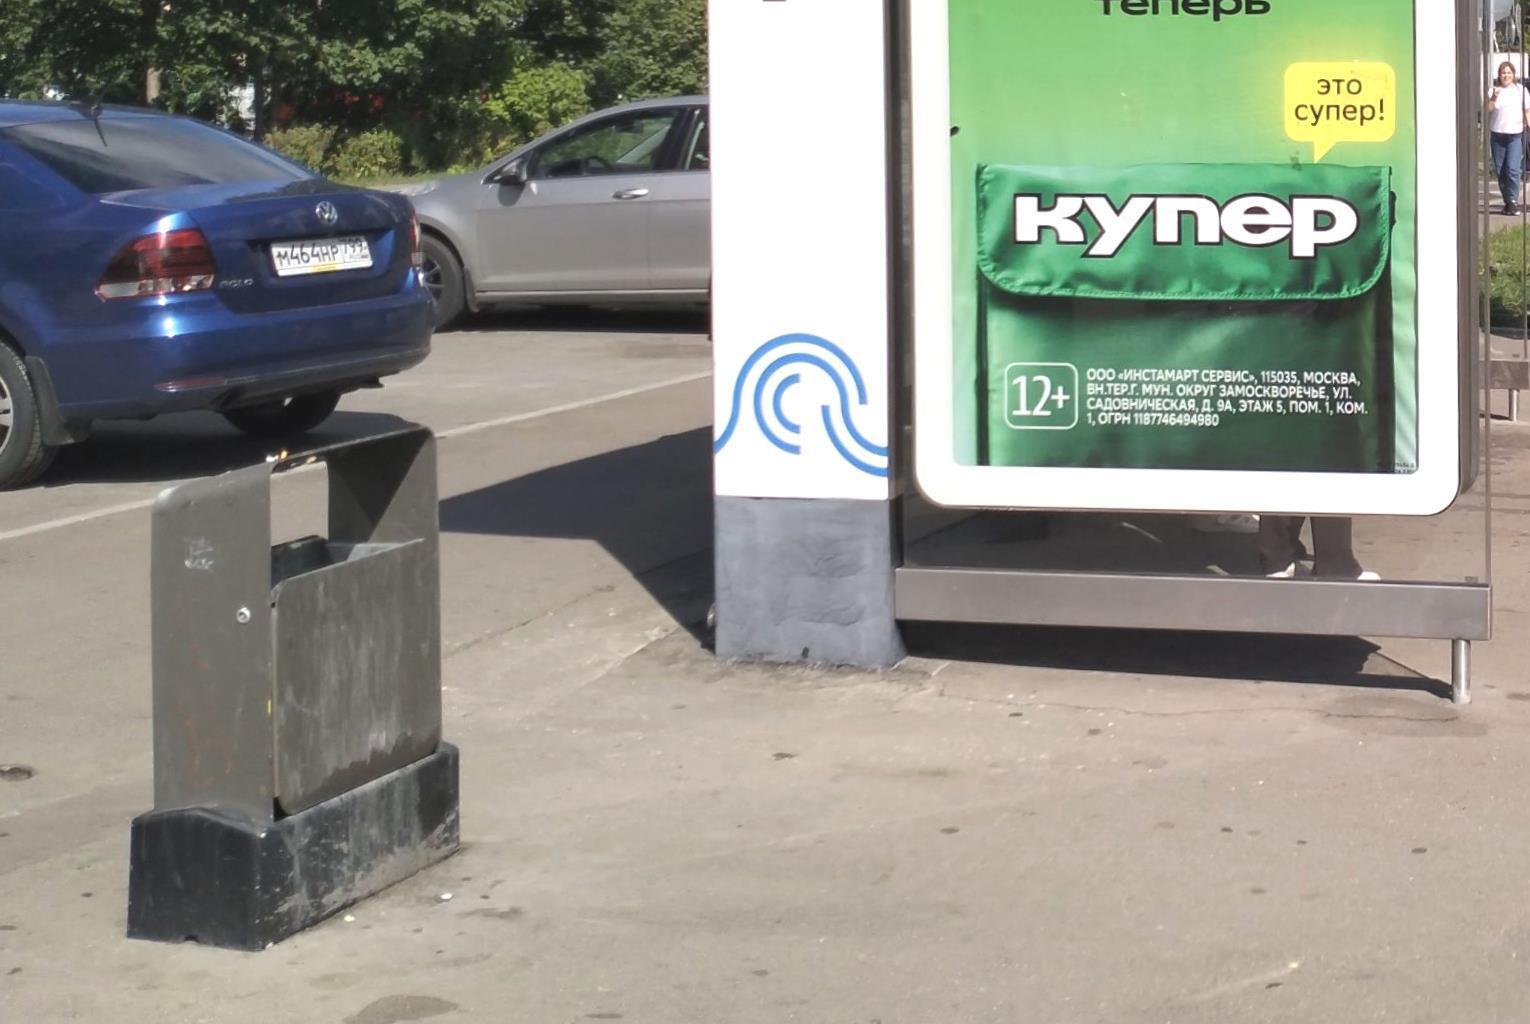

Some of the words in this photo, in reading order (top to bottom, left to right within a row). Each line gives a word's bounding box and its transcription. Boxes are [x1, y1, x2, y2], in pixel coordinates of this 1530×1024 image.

[1316, 79, 1363, 96] это
[1294, 98, 1386, 126] супер!
[1013, 192, 1360, 260] купер
[1087, 368, 1116, 382] ООО
[1117, 368, 1199, 383] «ИНСТАМАРТ
[1200, 370, 1258, 385] СЕРВИС»,
[1260, 371, 1300, 385] 115035,
[1303, 372, 1361, 387] МОСКВА,
[1011, 374, 1071, 417] 12+
[1141, 384, 1171, 397] МУН.
[1176, 384, 1217, 398] ОКРУГ
[1218, 385, 1330, 400] ЗАМОСКВОРЕЧЬЕ,
[1332, 386, 1352, 400] УЛ.
[1086, 398, 1199, 413] САДОВНИЧЕСКАЯ,
[1201, 400, 1215, 413] Д.
[1216, 400, 1237, 414] 9А,
[1238, 400, 1274, 413] ЭТАЖ
[1276, 401, 1287, 415] 5,
[1288, 401, 1322, 414] ПОМ.
[1325, 402, 1334, 416] 1,
[1336, 402, 1369, 415] КОМ.
[1087, 413, 1096, 426] 1,
[1098, 413, 1131, 425] ОГРН
[1133, 413, 1220, 427] 1187746494980
